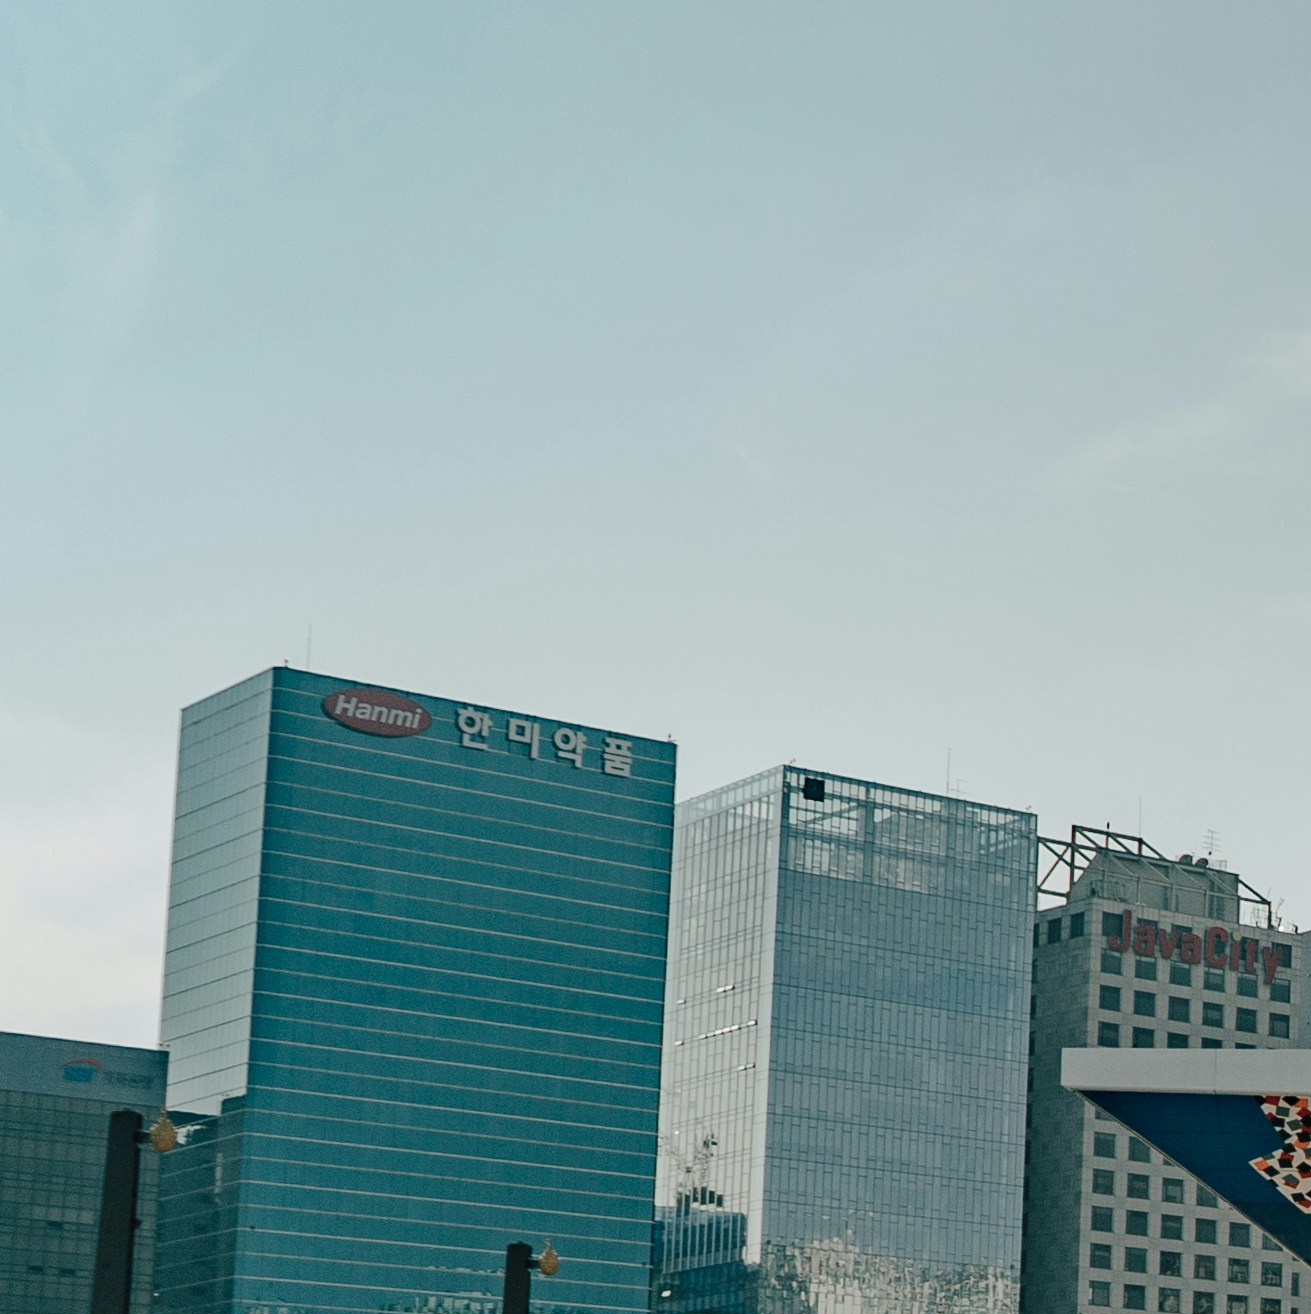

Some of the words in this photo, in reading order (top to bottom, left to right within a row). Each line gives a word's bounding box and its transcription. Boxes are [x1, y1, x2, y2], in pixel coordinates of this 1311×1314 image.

[334, 694, 423, 730] Hanmi
[456, 706, 633, 778] 한미약품
[1108, 908, 1283, 986] JavaCity
